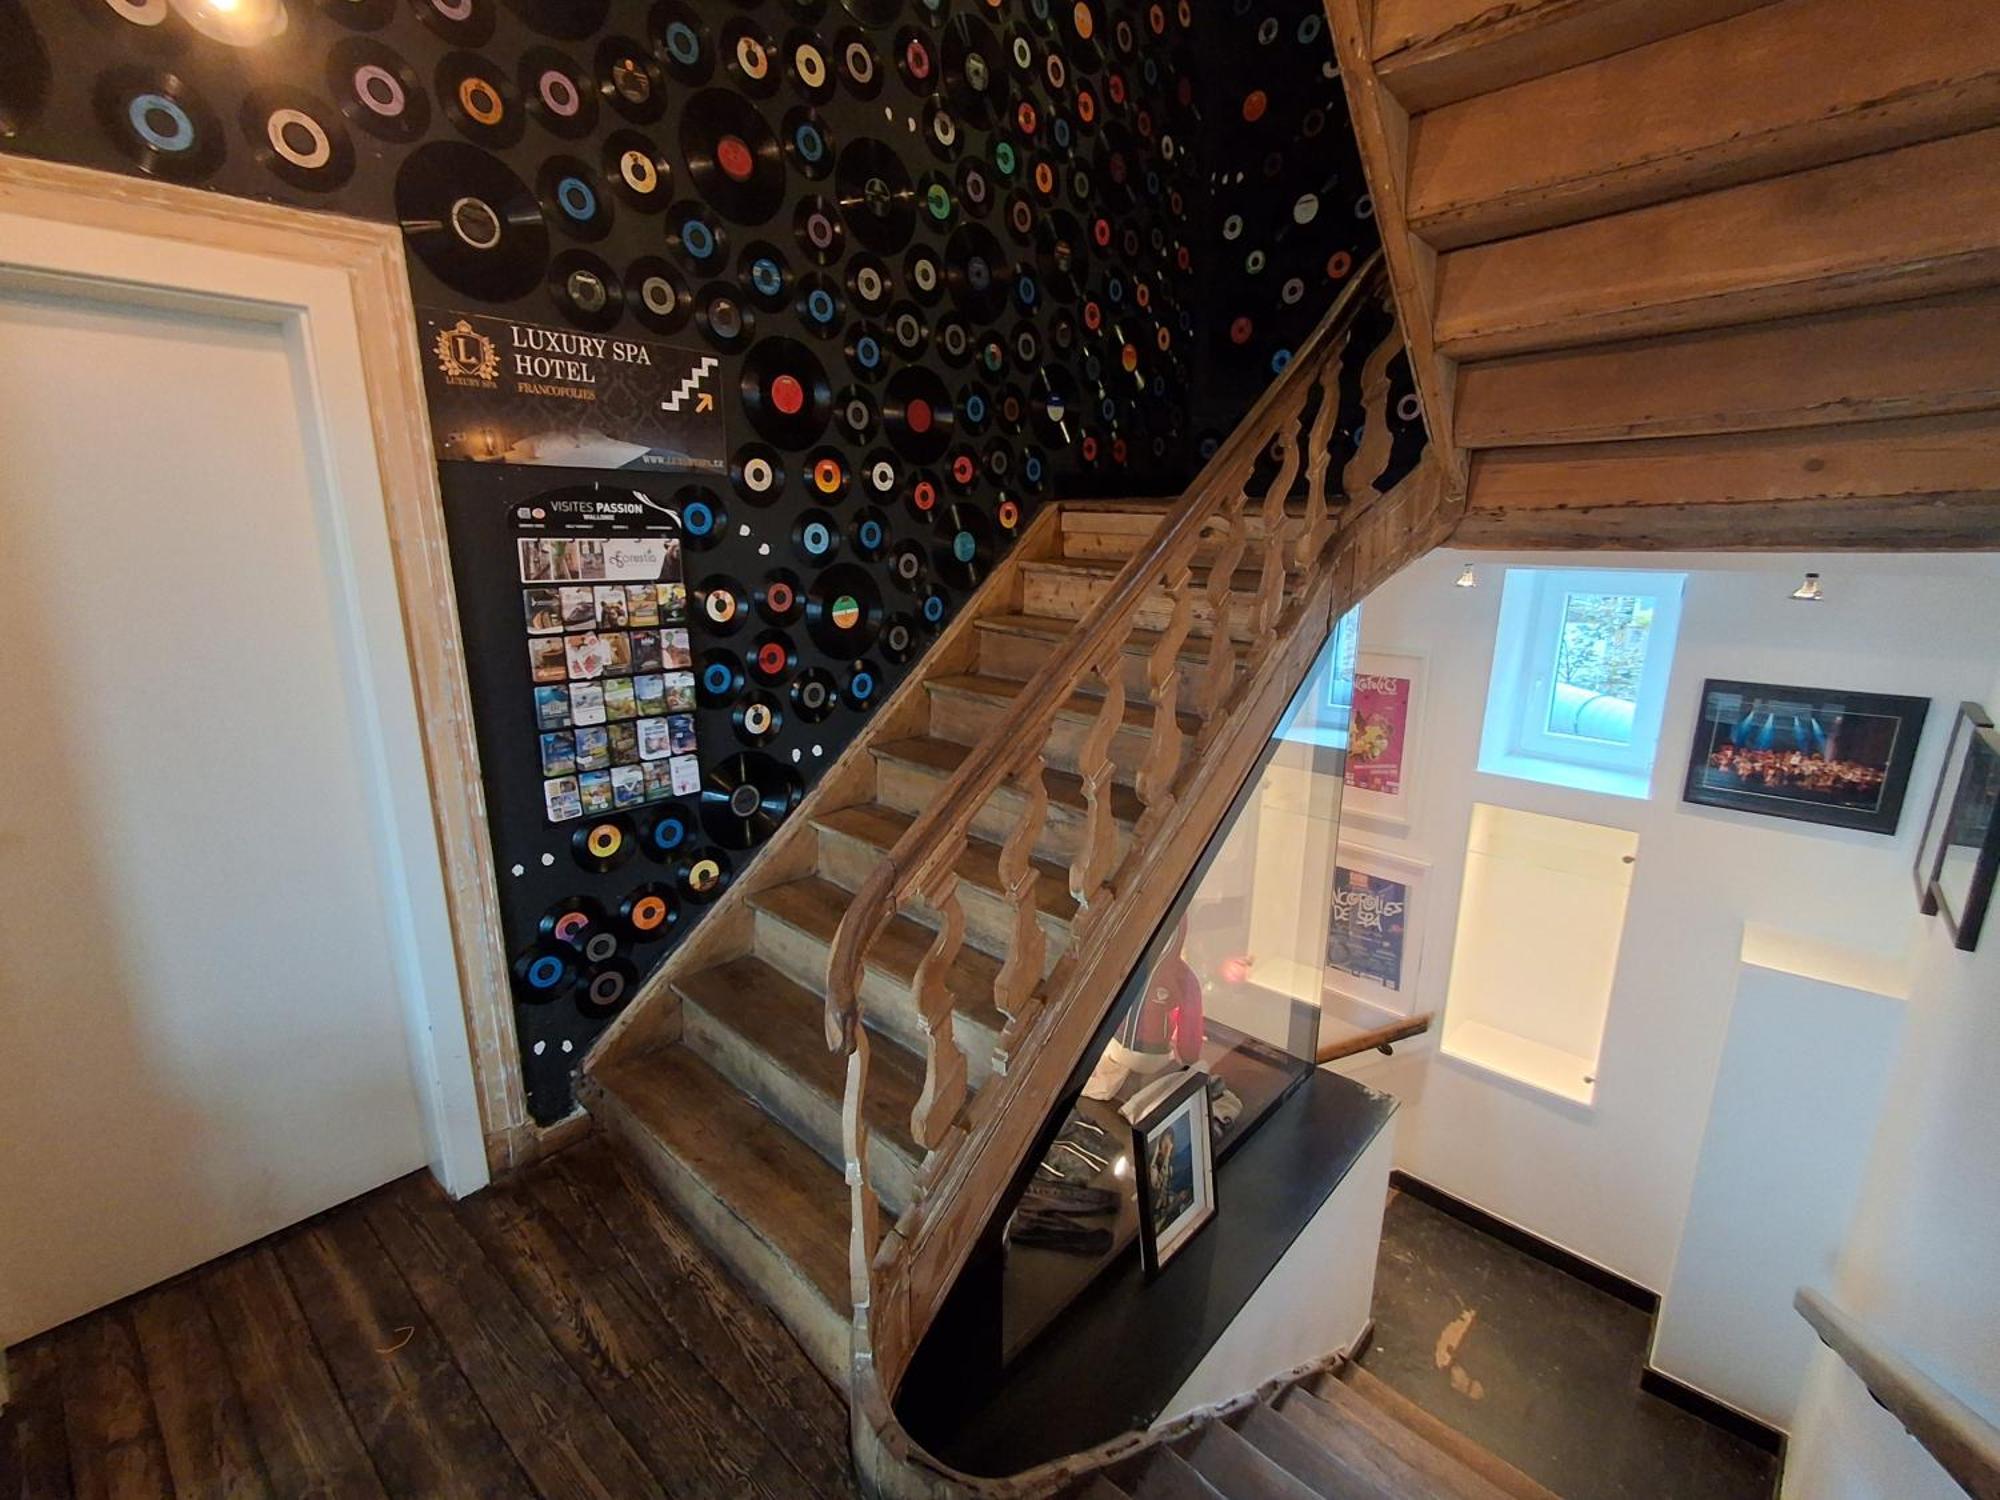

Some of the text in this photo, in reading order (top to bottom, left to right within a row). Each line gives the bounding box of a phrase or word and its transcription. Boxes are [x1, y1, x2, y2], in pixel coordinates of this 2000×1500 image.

[457, 337, 478, 364] L
[511, 326, 651, 366] LUXURY SPA
[514, 354, 596, 383] HOTEL
[518, 382, 597, 400] FRANCOFOLIES
[551, 501, 643, 515] VISITES PASSION
